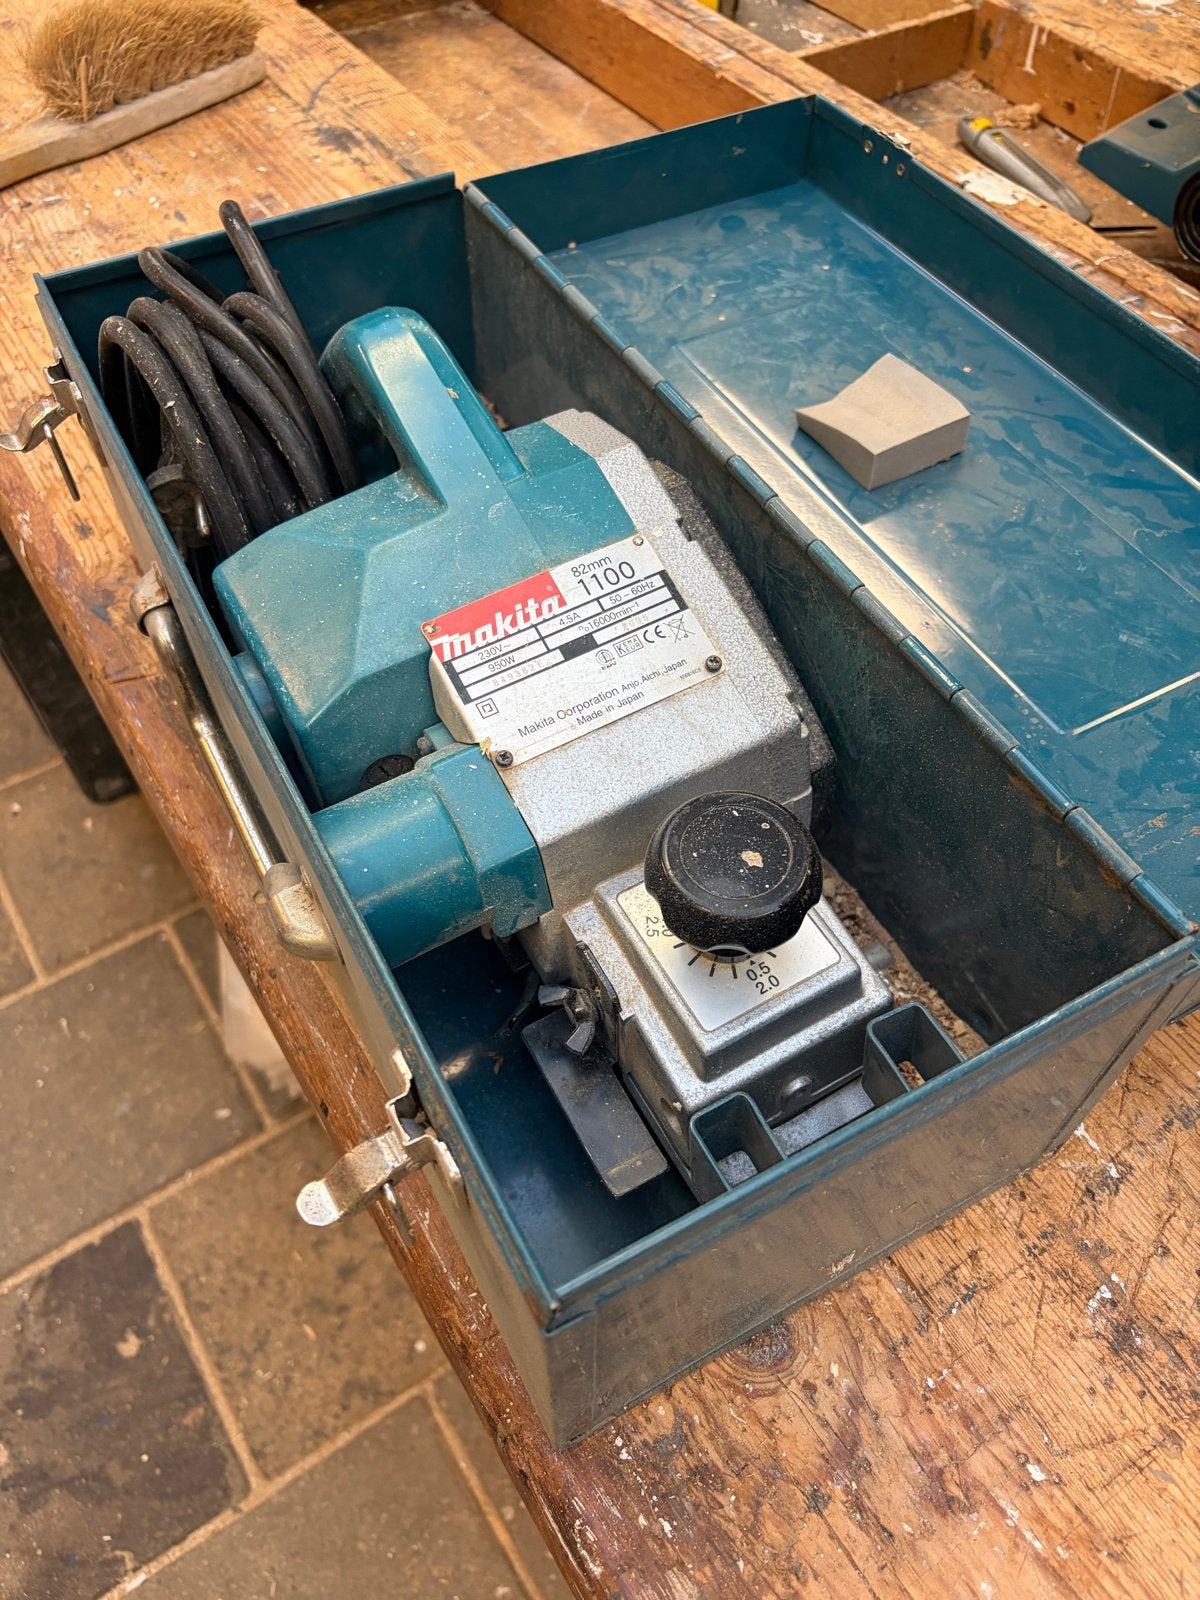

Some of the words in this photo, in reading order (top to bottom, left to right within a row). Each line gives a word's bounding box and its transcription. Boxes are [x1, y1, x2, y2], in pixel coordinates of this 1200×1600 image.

[570, 556, 612, 577] 82mm
[577, 561, 635, 596] 1100
[559, 612, 581, 625] 4.5A
[643, 625, 666, 643] CE
[488, 655, 515, 672] 950W
[517, 717, 556, 737] Makita
[556, 688, 619, 720] Corporation
[576, 710, 603, 725] Made
[605, 705, 615, 713] in
[617, 691, 645, 708] Japan
[646, 916, 660, 937] 2.5
[746, 961, 771, 981] 0.5
[755, 975, 780, 995] 2.0
